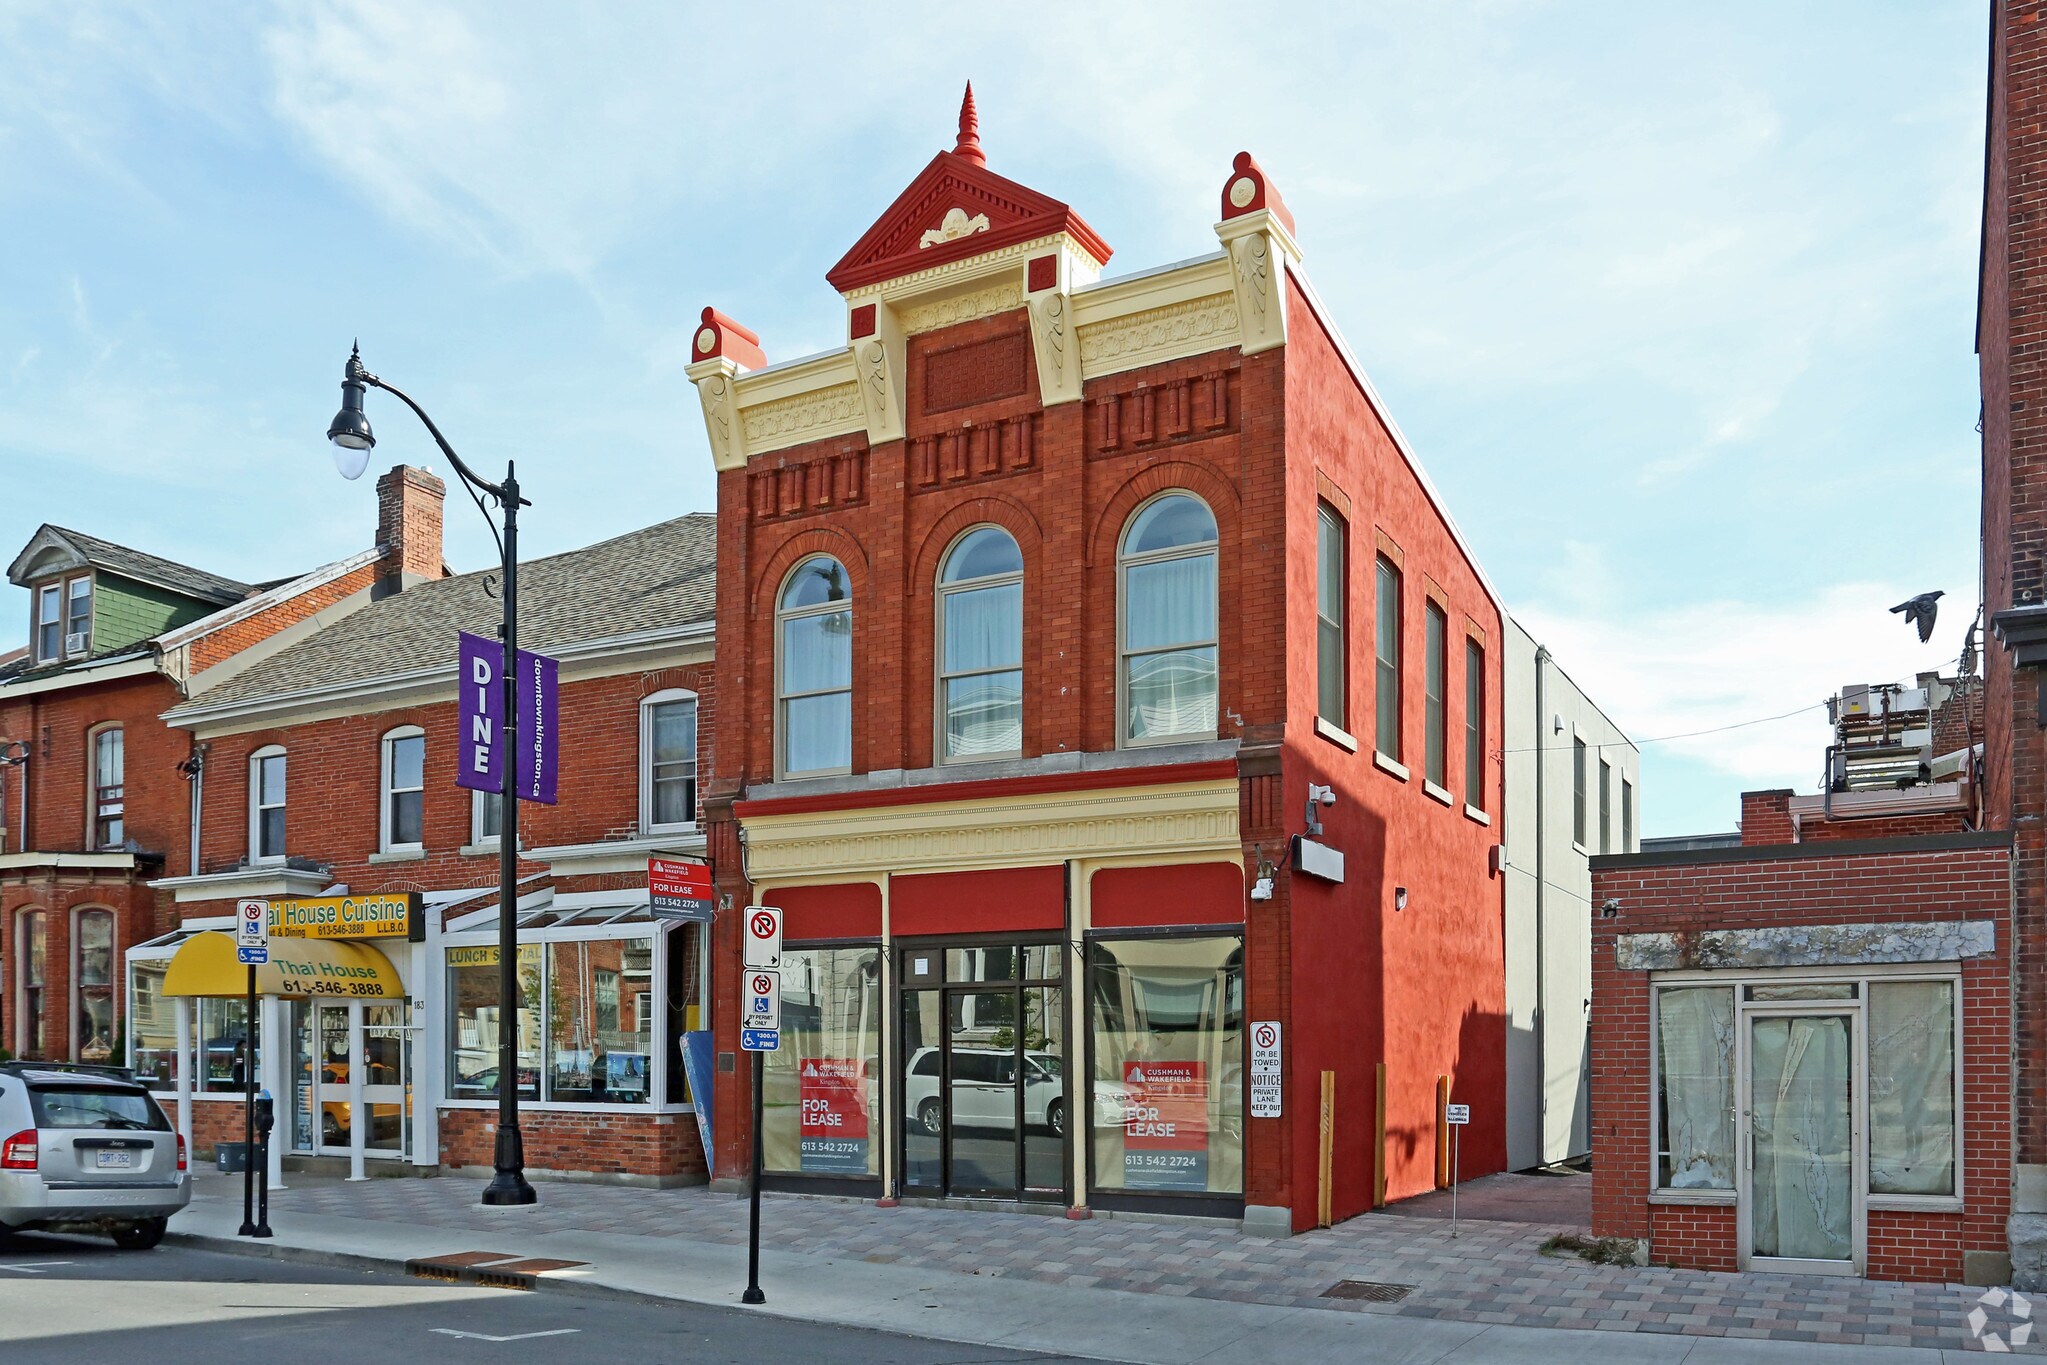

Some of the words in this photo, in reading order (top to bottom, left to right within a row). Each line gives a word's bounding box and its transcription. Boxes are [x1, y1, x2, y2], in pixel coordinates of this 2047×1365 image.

[473, 656, 492, 774] DINE
[533, 658, 544, 797] downtownkingston.ca
[653, 883, 669, 892] FOR
[670, 885, 692, 894] LEASE
[654, 897, 666, 905] 613
[667, 898, 681, 906] 542
[682, 900, 699, 908] 2724
[285, 902, 336, 925] House
[342, 897, 406, 923] Cuisine
[278, 928, 282, 937] &
[285, 927, 306, 938] Dining
[318, 924, 365, 936] 613-546-3888
[377, 922, 406, 933] L.L.B.O.
[450, 950, 487, 963] LUNCH
[272, 960, 317, 976] Thai
[318, 962, 378, 978] House
[414, 1001, 424, 1010] 183
[1251, 1074, 1280, 1086] NOTICE
[802, 1100, 829, 1112] FOR
[802, 1114, 842, 1126] LEASE
[1127, 1108, 1159, 1121] FOR
[1127, 1123, 1176, 1137] LEASE
[802, 1142, 816, 1151] 613
[818, 1143, 835, 1151] 542
[837, 1143, 859, 1152] 2724
[1125, 1155, 1142, 1165] 613
[1146, 1156, 1166, 1166] 542
[1170, 1157, 1196, 1166] 2724
